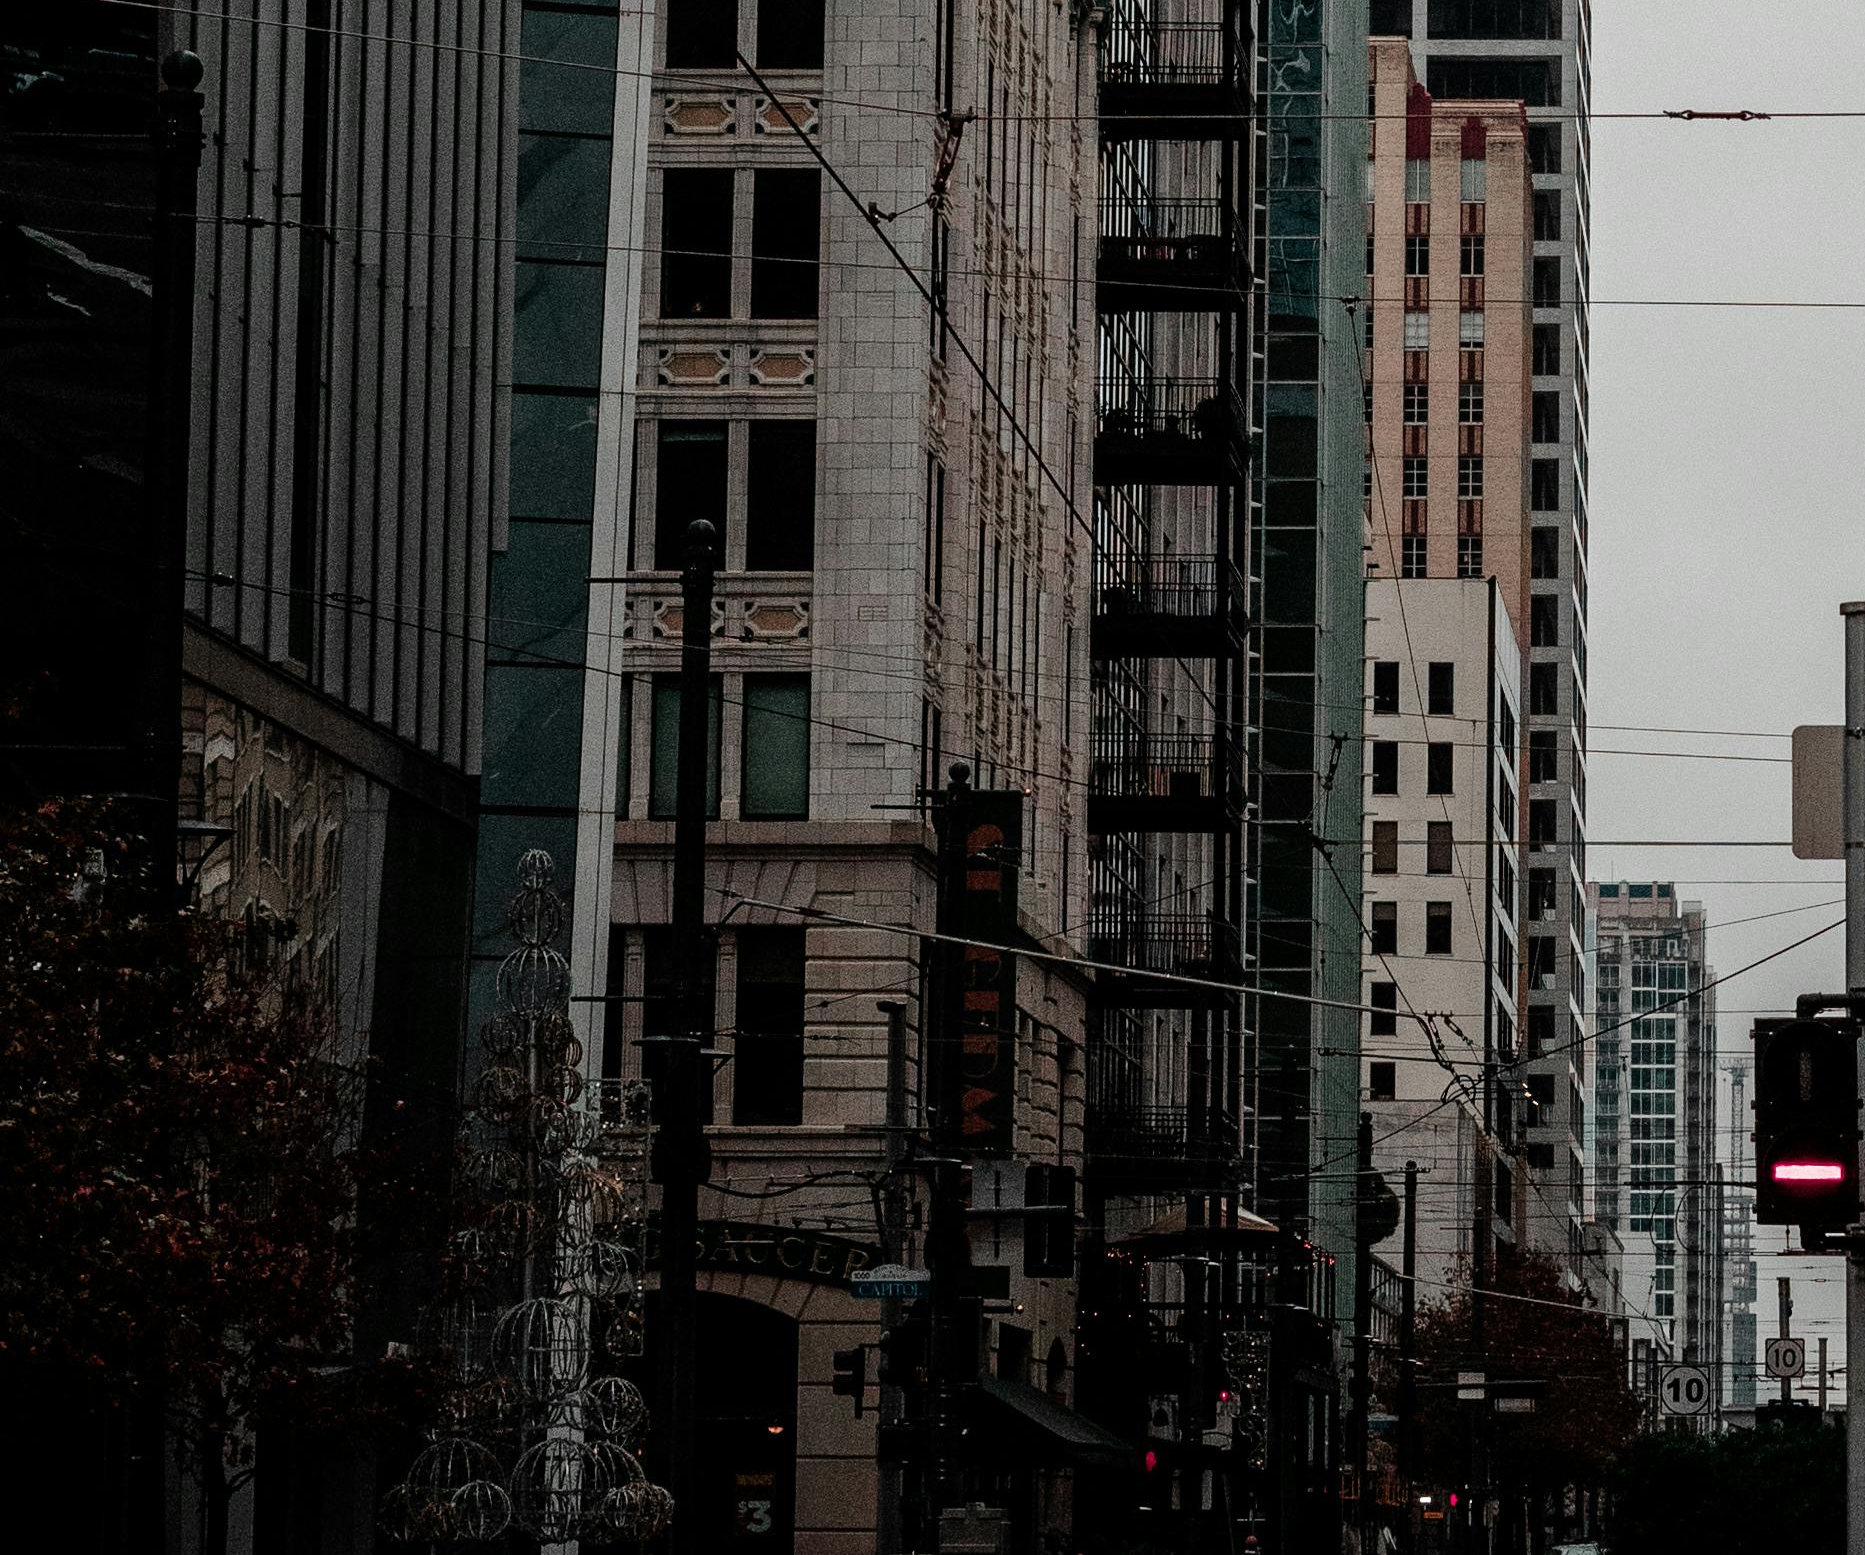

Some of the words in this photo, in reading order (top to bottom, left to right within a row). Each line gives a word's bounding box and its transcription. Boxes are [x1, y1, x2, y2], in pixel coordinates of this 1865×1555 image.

[858, 1282, 923, 1297] CAPITOL
[1773, 1348, 1797, 1368] 10
[1667, 1378, 1705, 1403] 10
[737, 1499, 772, 1534] $3
